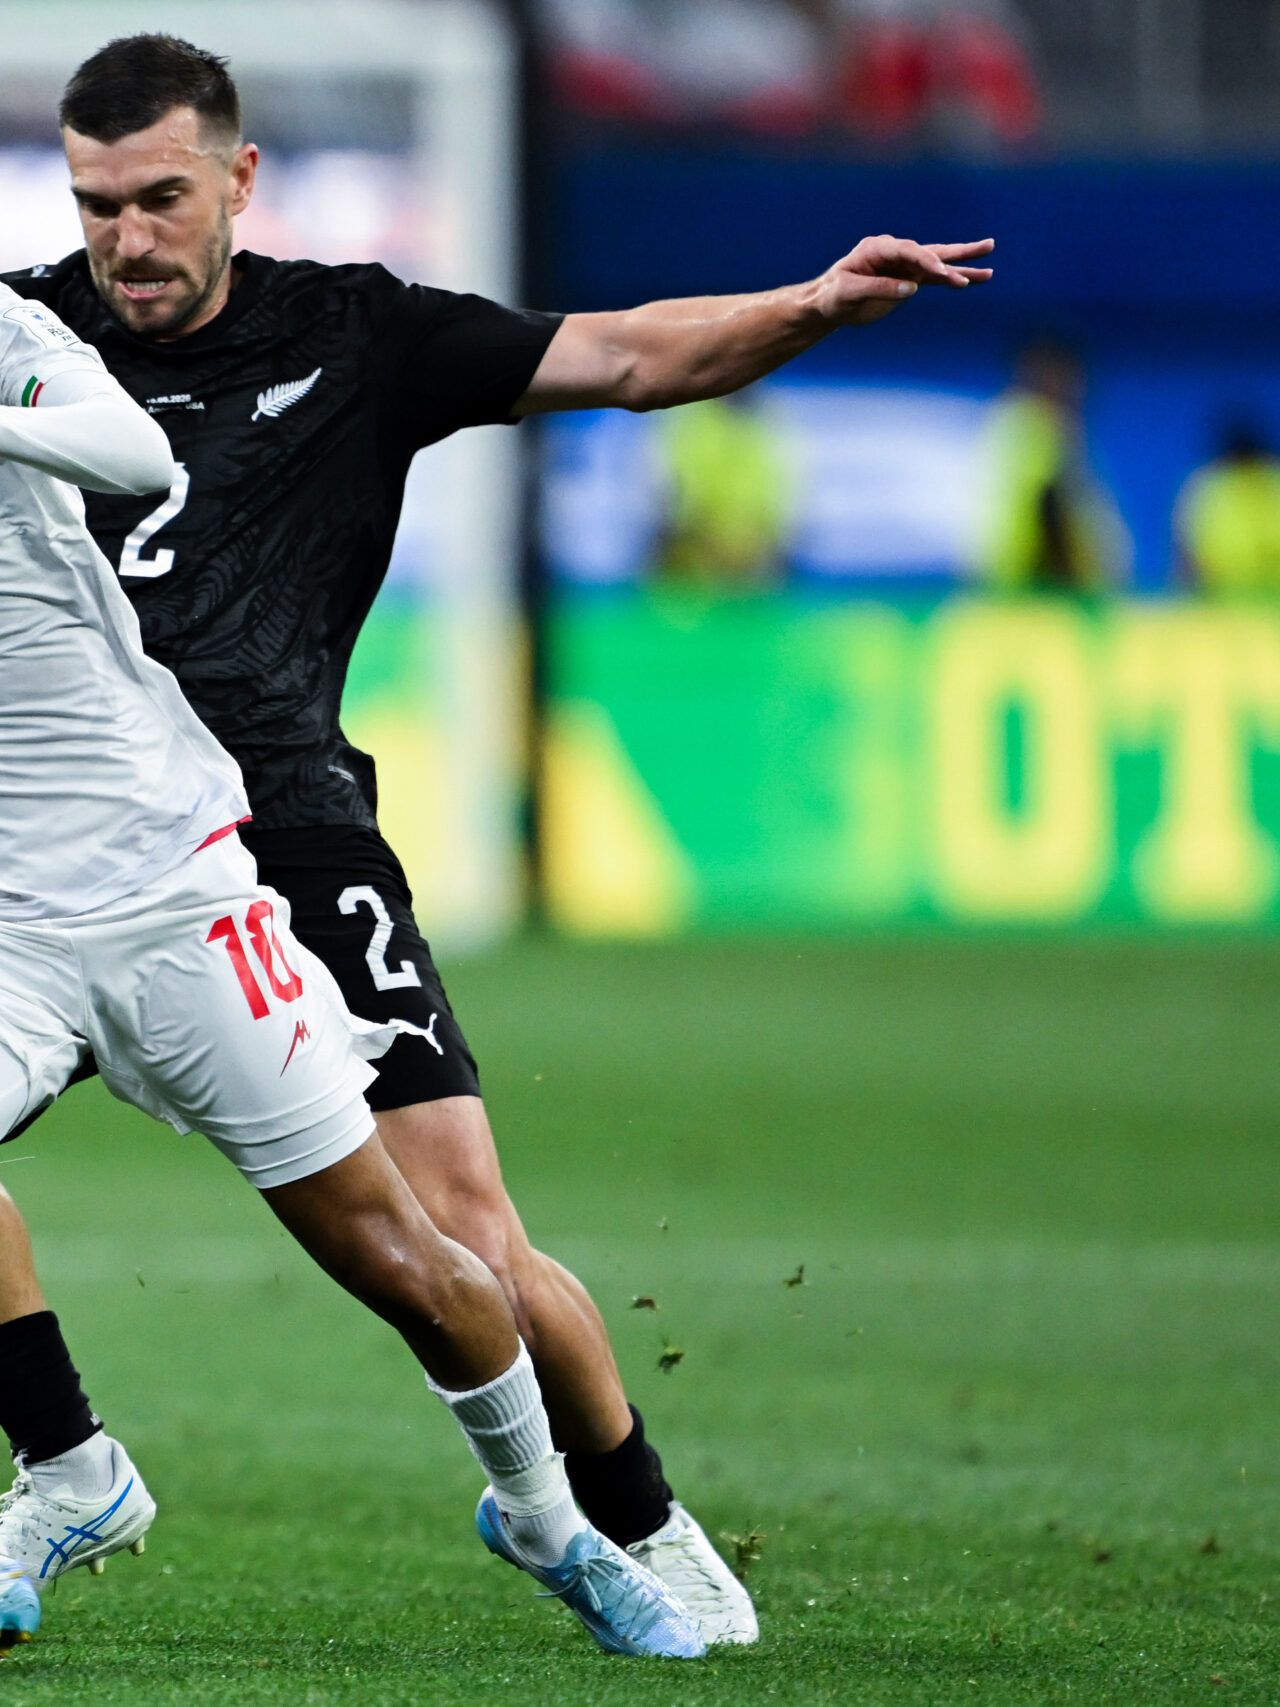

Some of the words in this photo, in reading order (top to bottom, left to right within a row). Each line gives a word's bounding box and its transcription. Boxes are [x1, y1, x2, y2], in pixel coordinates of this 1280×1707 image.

[118, 462, 190, 578] 2
[205, 899, 303, 1021] 10
[337, 885, 422, 992] 2
